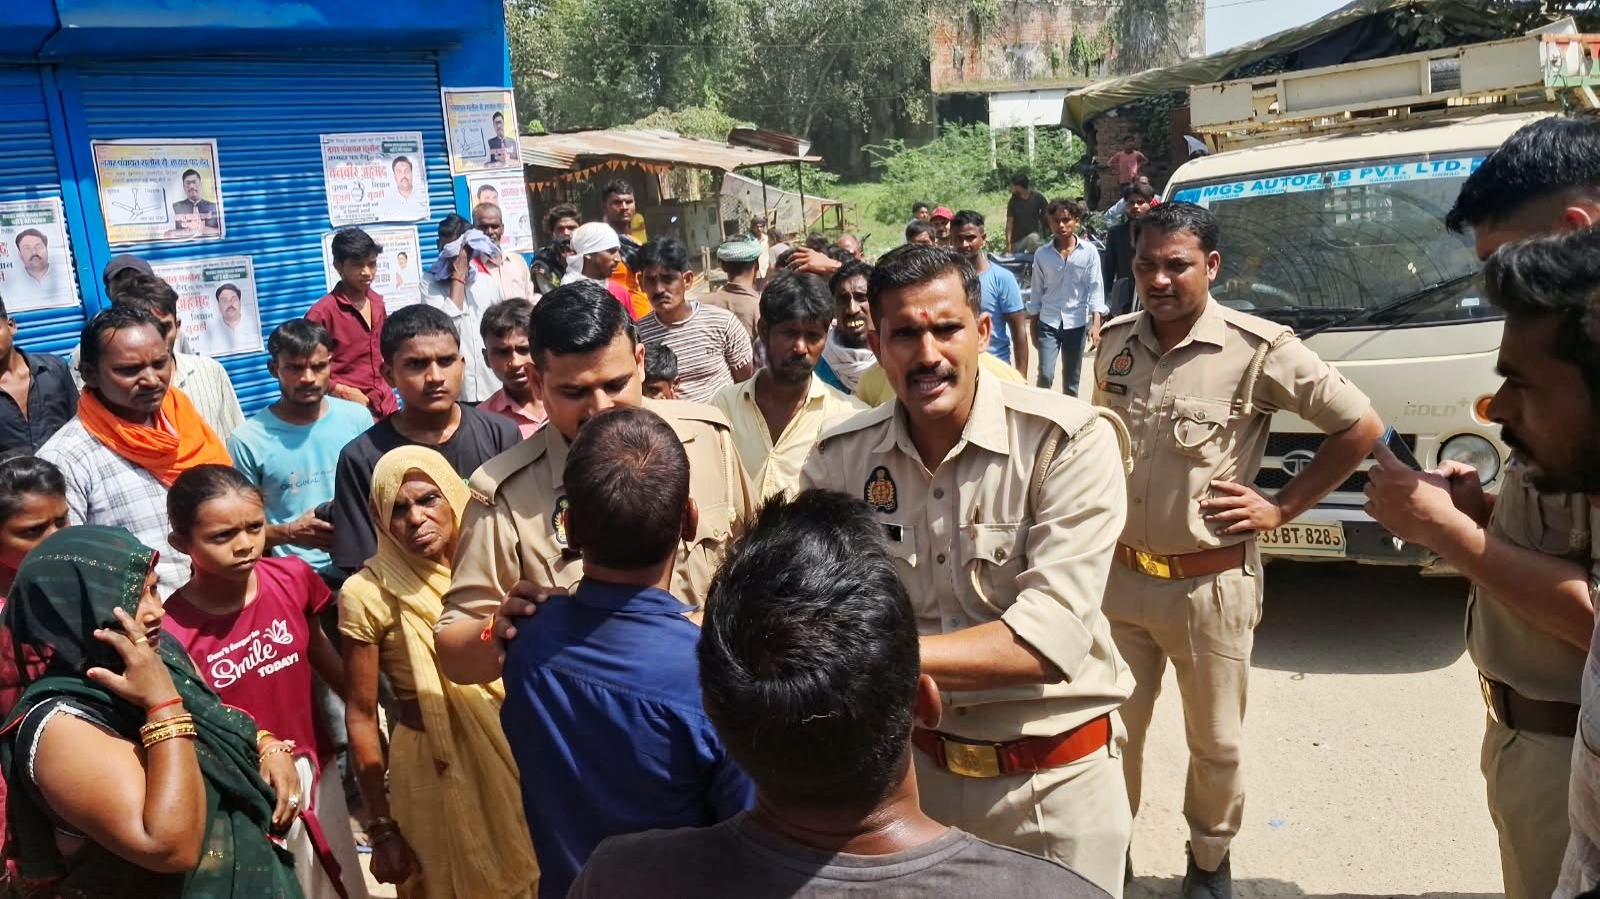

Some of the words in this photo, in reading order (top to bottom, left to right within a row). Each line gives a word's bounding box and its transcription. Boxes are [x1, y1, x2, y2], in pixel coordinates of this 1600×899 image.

[1204, 182, 1244, 197] MGS
[1360, 164, 1406, 179] PVT.
[1416, 160, 1466, 174] LTD.
[206, 646, 230, 663] Don't
[229, 634, 251, 652] forget
[250, 630, 260, 638] to
[211, 638, 278, 688] Smile
[257, 652, 300, 678] TODAY!
